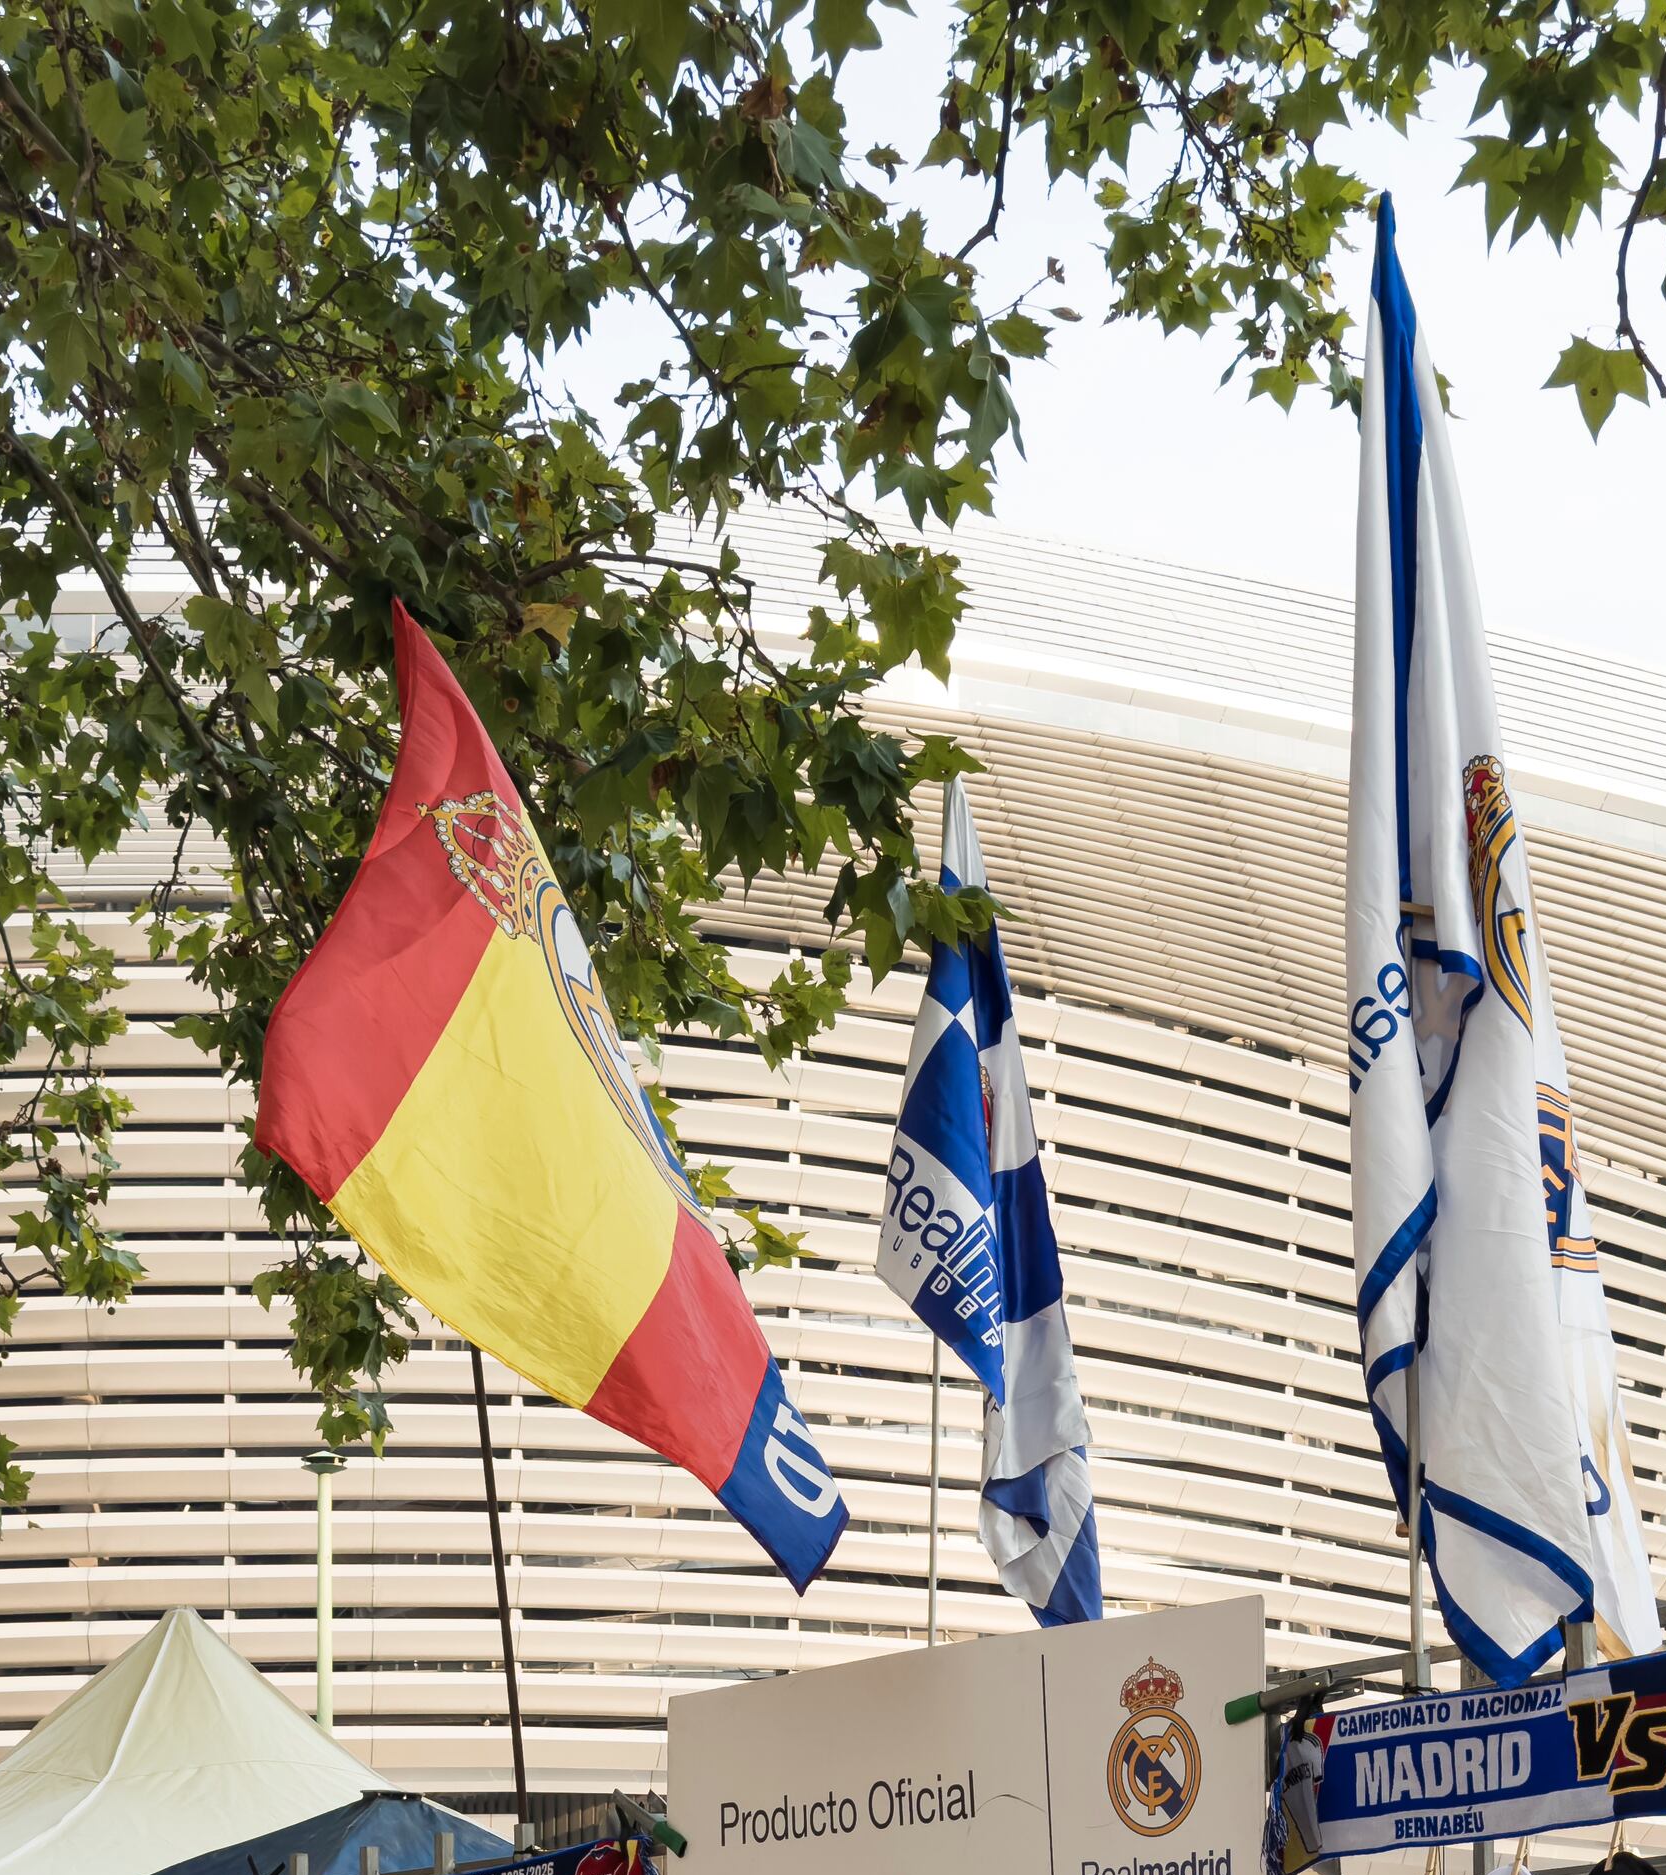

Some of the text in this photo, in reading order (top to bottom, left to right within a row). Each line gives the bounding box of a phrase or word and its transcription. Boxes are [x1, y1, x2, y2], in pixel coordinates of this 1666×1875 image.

[1337, 1688, 1562, 1738] CAMPEONATO NACIONAL
[1355, 1730, 1532, 1808] MADRID
[720, 1770, 977, 1847] Producto Oficial
[1394, 1806, 1485, 1841] BERNABÉU
